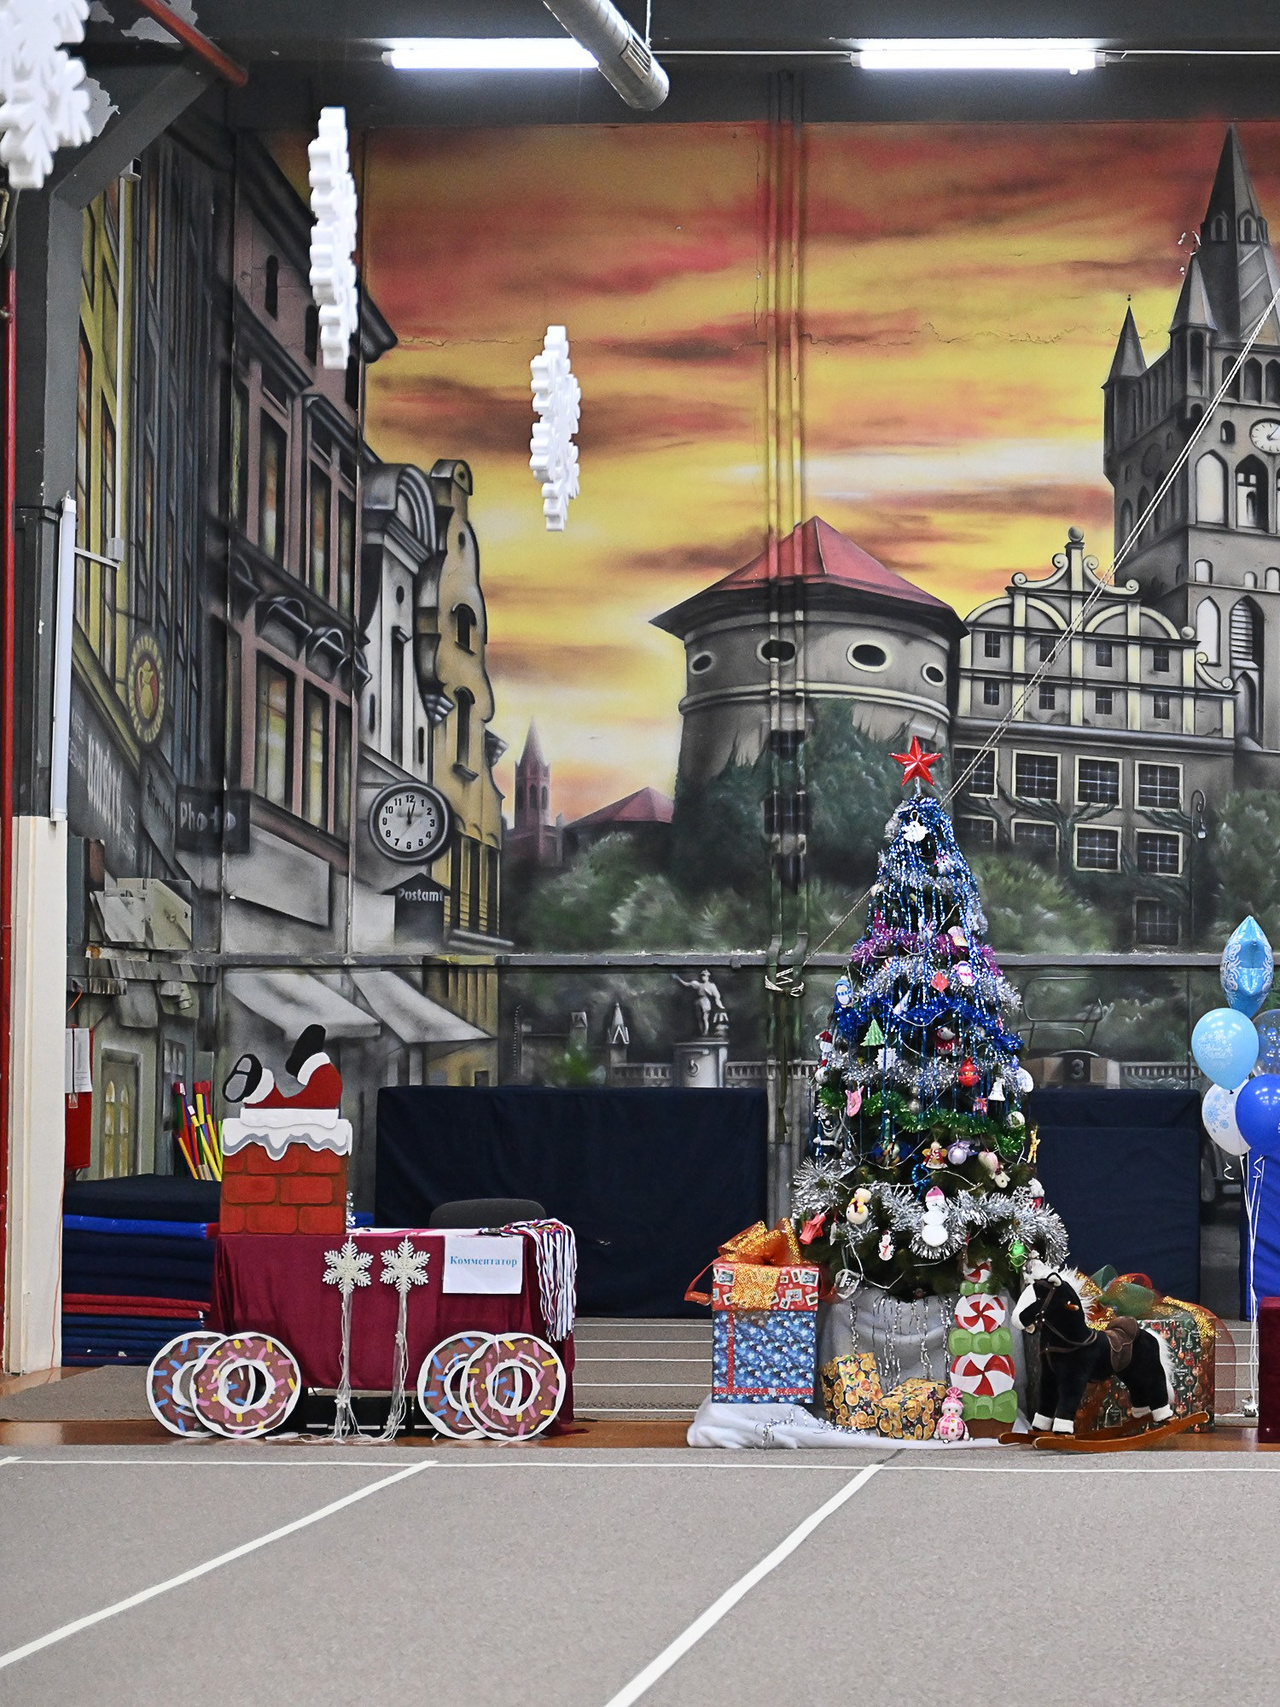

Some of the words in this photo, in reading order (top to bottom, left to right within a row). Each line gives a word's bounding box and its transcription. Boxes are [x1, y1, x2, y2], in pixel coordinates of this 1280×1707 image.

[394, 798, 402, 806] 11
[405, 794, 415, 803] 12
[421, 799, 425, 807] 1
[385, 806, 394, 814] 10
[426, 807, 432, 816] 2
[180, 801, 237, 833] Photo
[382, 817, 387, 826] 9
[429, 819, 435, 827] 3
[385, 829, 391, 838] 8
[425, 831, 432, 839] 4
[394, 838, 400, 846] 7
[406, 841, 412, 850] 6
[418, 838, 423, 847] 5
[398, 888, 444, 902] Postamt
[1070, 1058, 1085, 1080] 3
[450, 1255, 518, 1268] Комментатор
